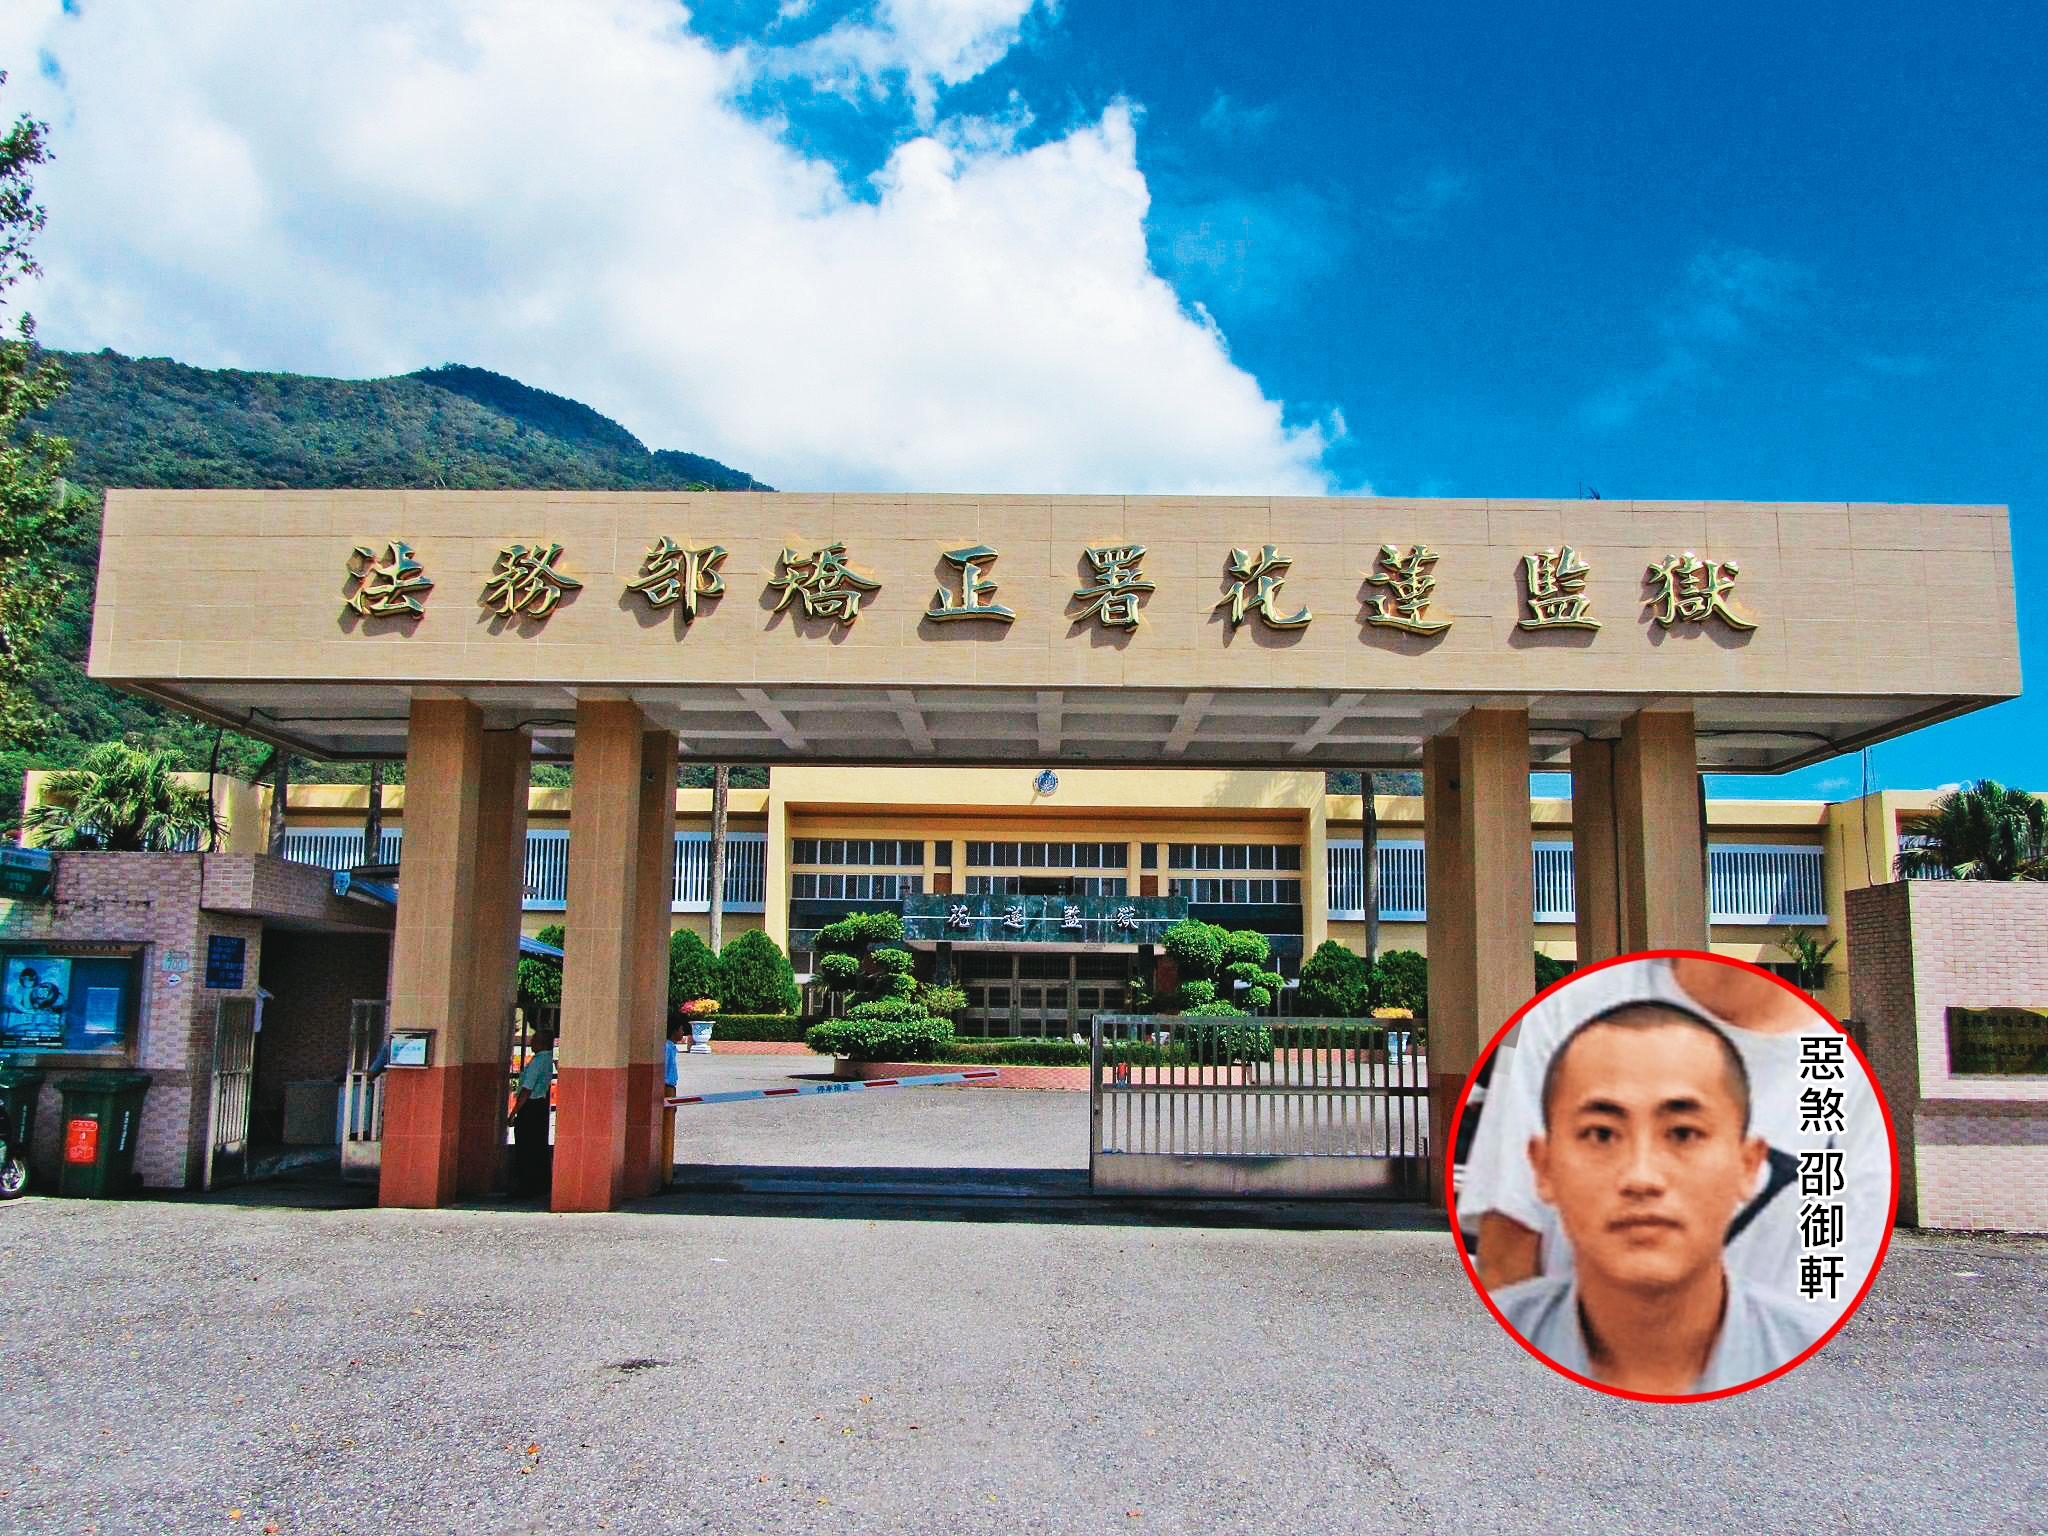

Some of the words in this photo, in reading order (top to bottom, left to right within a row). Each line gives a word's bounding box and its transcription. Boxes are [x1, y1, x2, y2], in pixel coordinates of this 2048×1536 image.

[345, 536, 1757, 635] 法務部矯正署花蓮監獄
[948, 904, 1139, 929] 花蓮監獄
